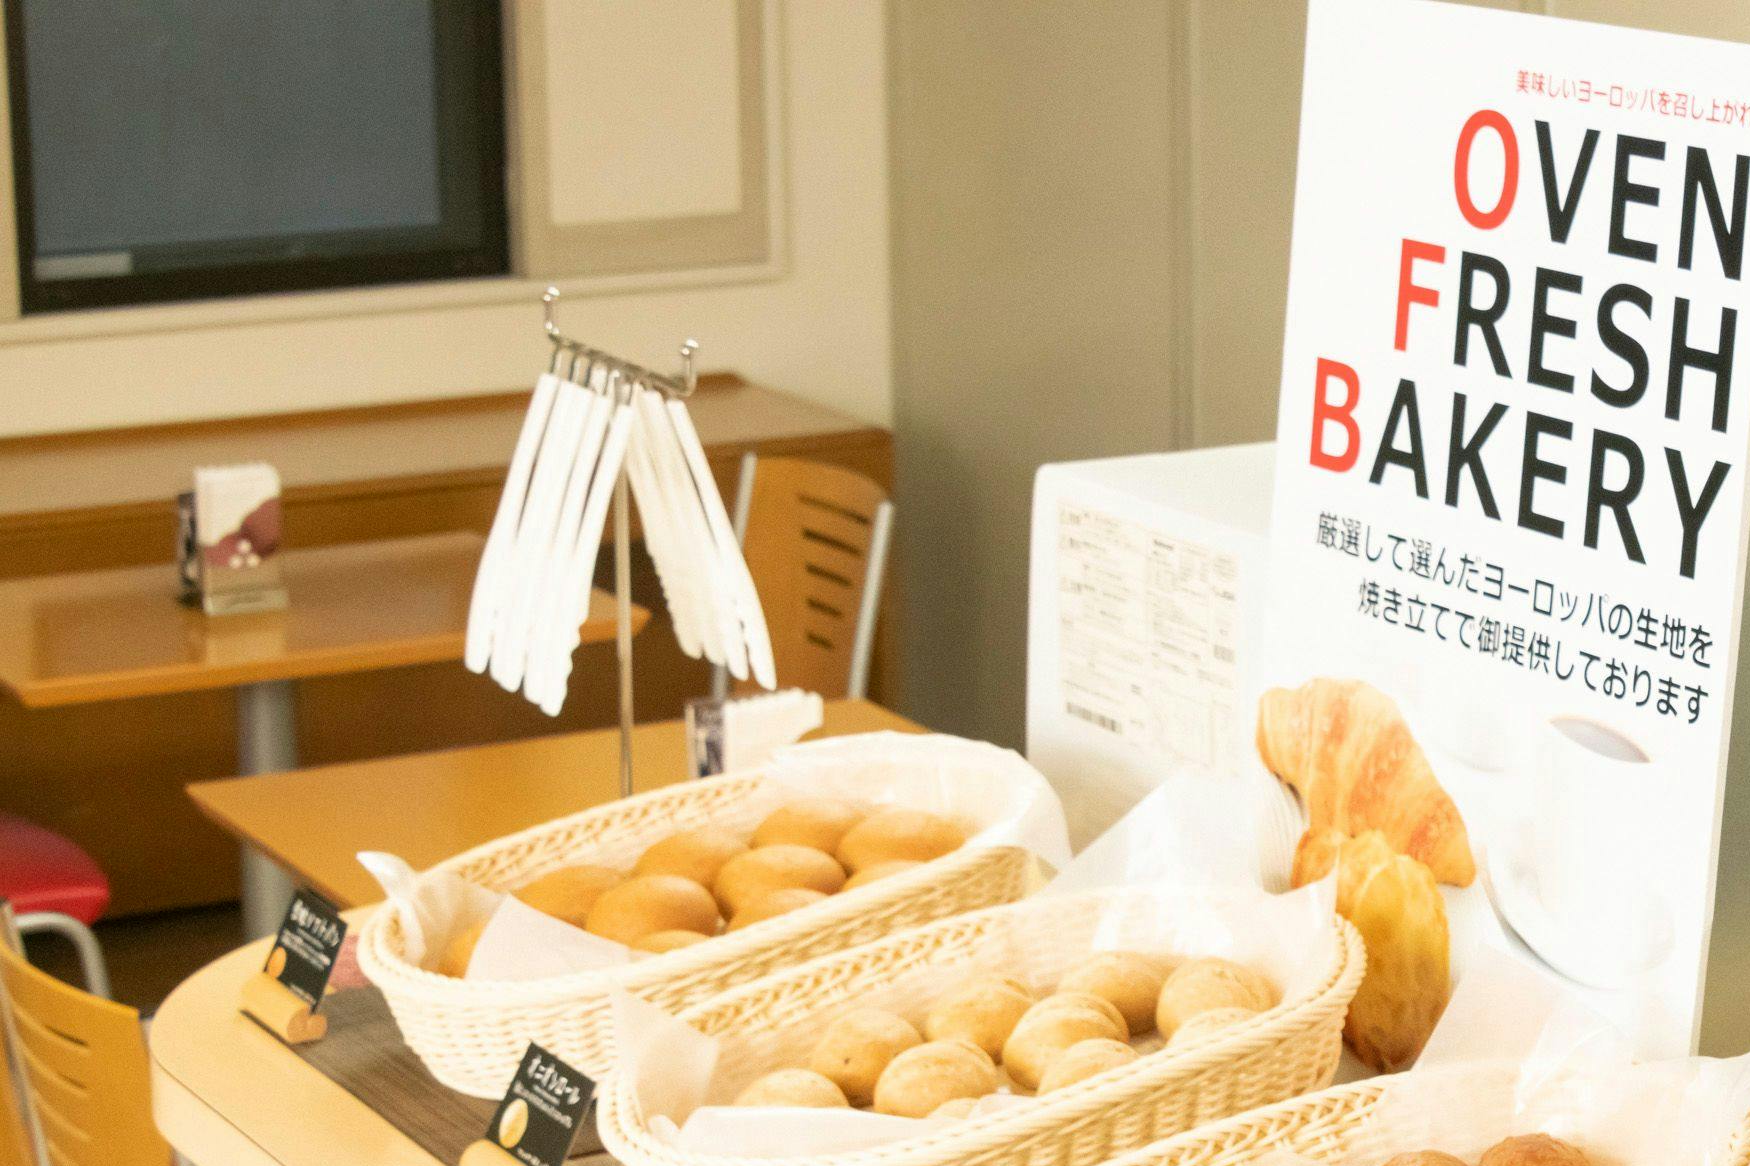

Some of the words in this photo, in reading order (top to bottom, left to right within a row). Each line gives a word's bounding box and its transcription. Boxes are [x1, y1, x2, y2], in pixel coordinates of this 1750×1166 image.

[1394, 238, 1738, 434] FRESH
[1309, 356, 1732, 581] BAKERY
[1315, 510, 1713, 669] 厳選して選んだヨーロッパの生地を
[1357, 577, 1709, 724] 焼き立てで御提供しております
